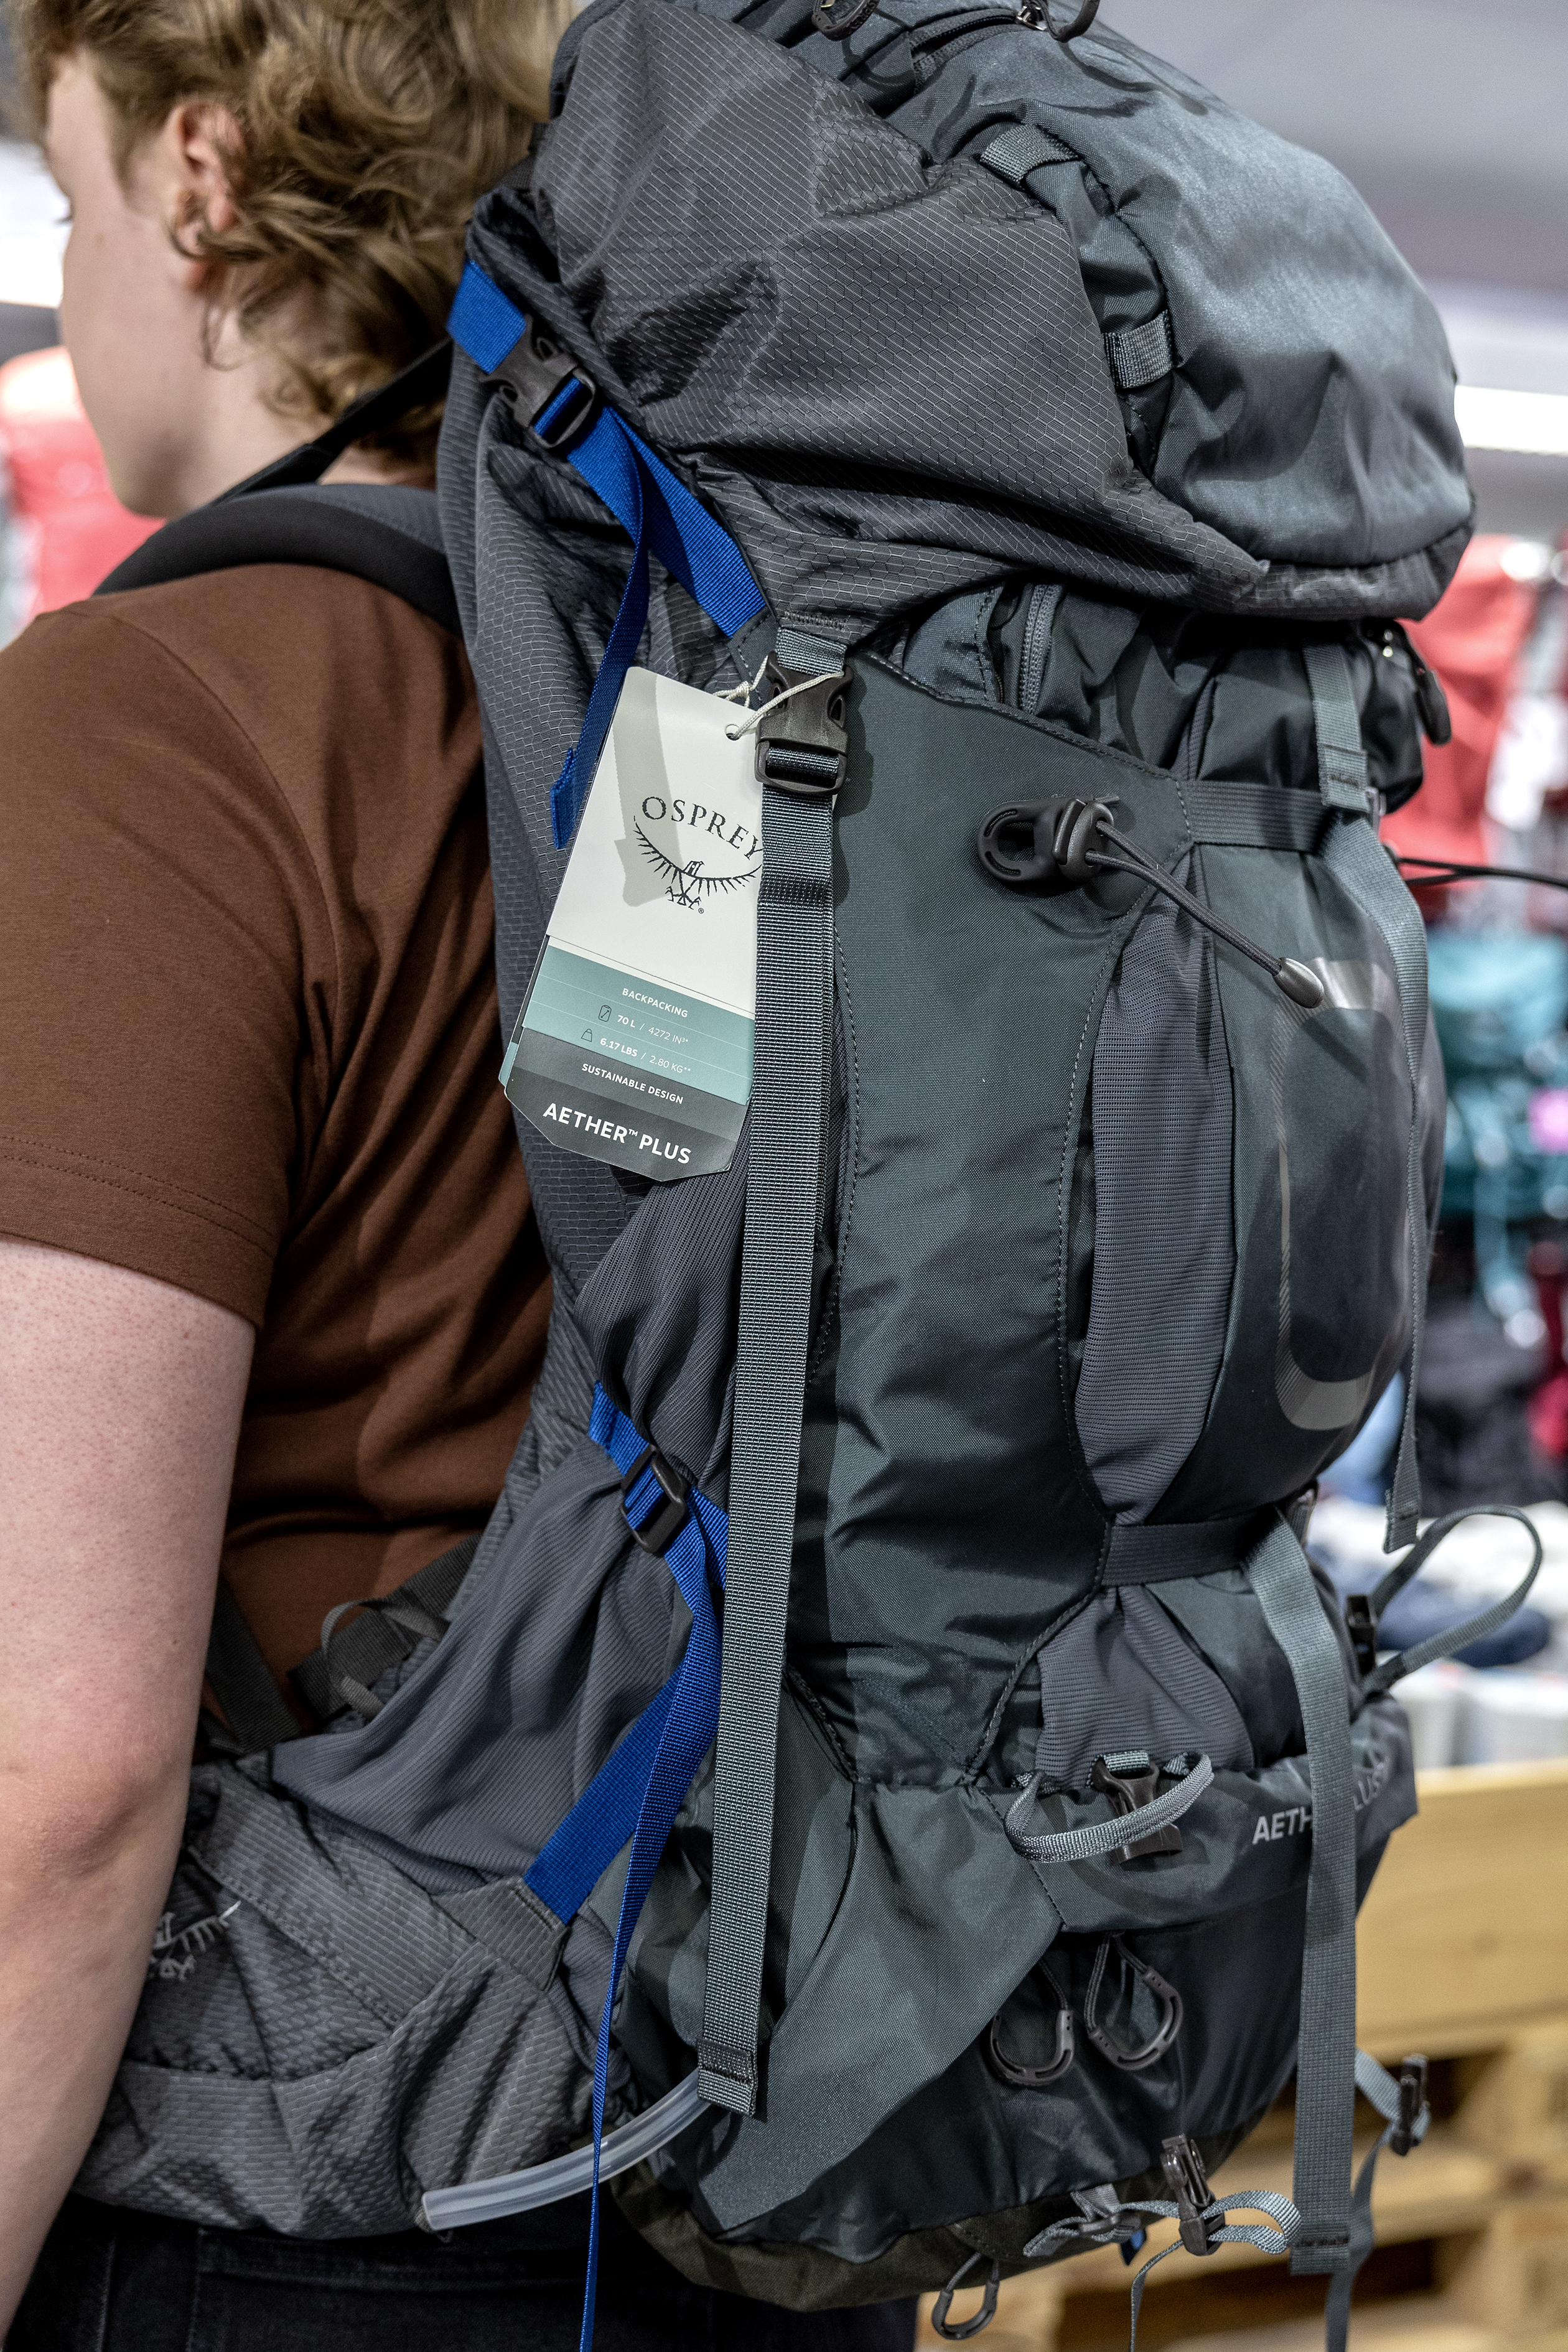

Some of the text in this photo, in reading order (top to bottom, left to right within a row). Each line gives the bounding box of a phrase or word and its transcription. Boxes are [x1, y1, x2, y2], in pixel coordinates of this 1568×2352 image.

[642, 796, 763, 860] OSPREY
[622, 987, 689, 1018] BACKPACKING
[617, 1014, 629, 1025] 70
[630, 1019, 635, 1028] L
[648, 1027, 671, 1040] 4272
[599, 1037, 620, 1050] 6.17
[620, 1045, 638, 1057] LBS
[649, 1055, 670, 1068] 2.80
[581, 1063, 684, 1104] SUSTAINABLE DESIGN
[638, 1133, 692, 1164] PLUS
[1251, 1775, 1381, 1845] AETH LUS
